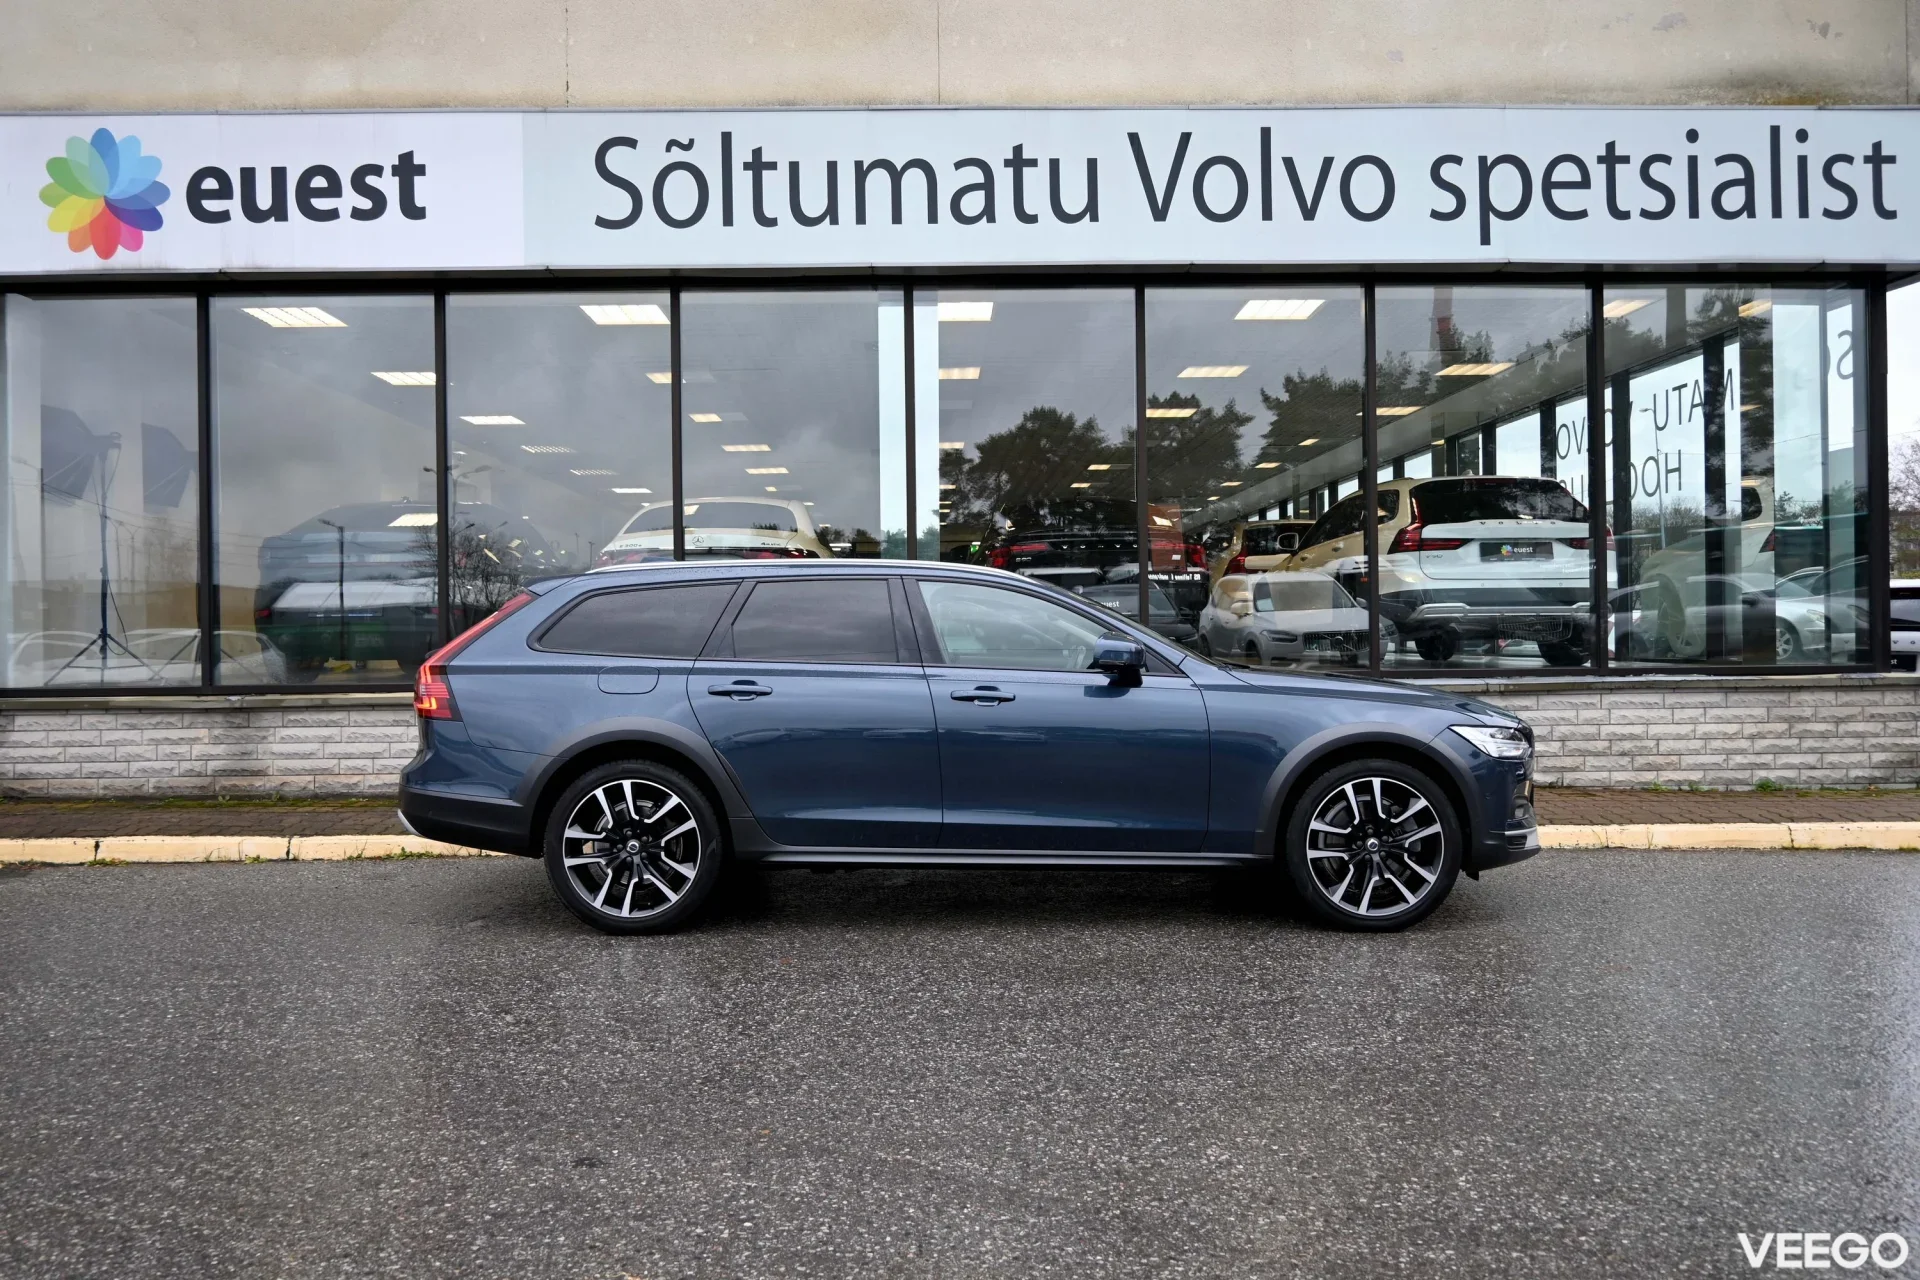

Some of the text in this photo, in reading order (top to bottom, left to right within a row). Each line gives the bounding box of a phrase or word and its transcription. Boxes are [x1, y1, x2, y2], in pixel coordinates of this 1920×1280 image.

[186, 150, 427, 224] euest
[595, 125, 1898, 246] Sõltumatu Volvo spetsialist
